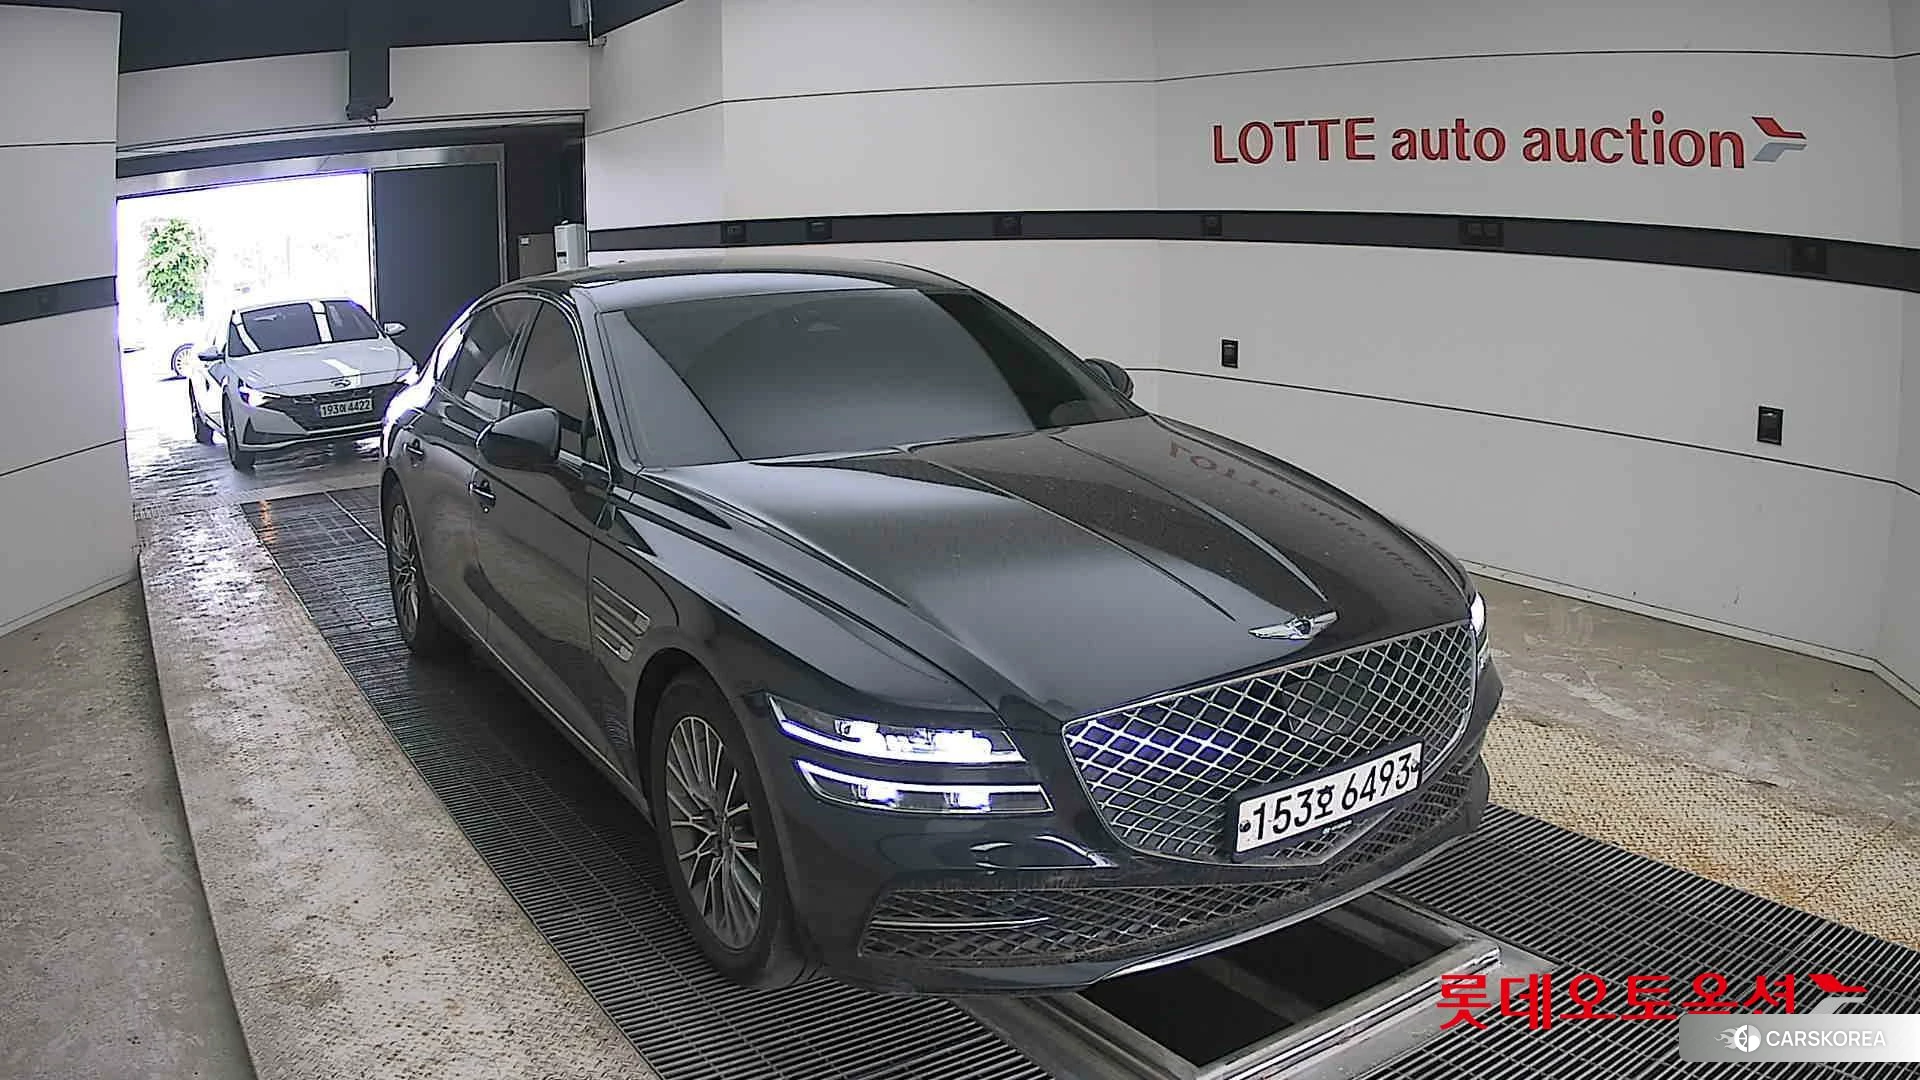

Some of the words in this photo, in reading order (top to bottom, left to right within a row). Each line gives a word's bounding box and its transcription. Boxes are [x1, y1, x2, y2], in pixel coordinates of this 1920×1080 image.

[1213, 118, 1375, 163] LOTTE
[1391, 118, 1506, 161] auto
[1522, 111, 1745, 168] auction
[1253, 785, 1335, 840] 153호
[1341, 753, 1412, 811] 6493
